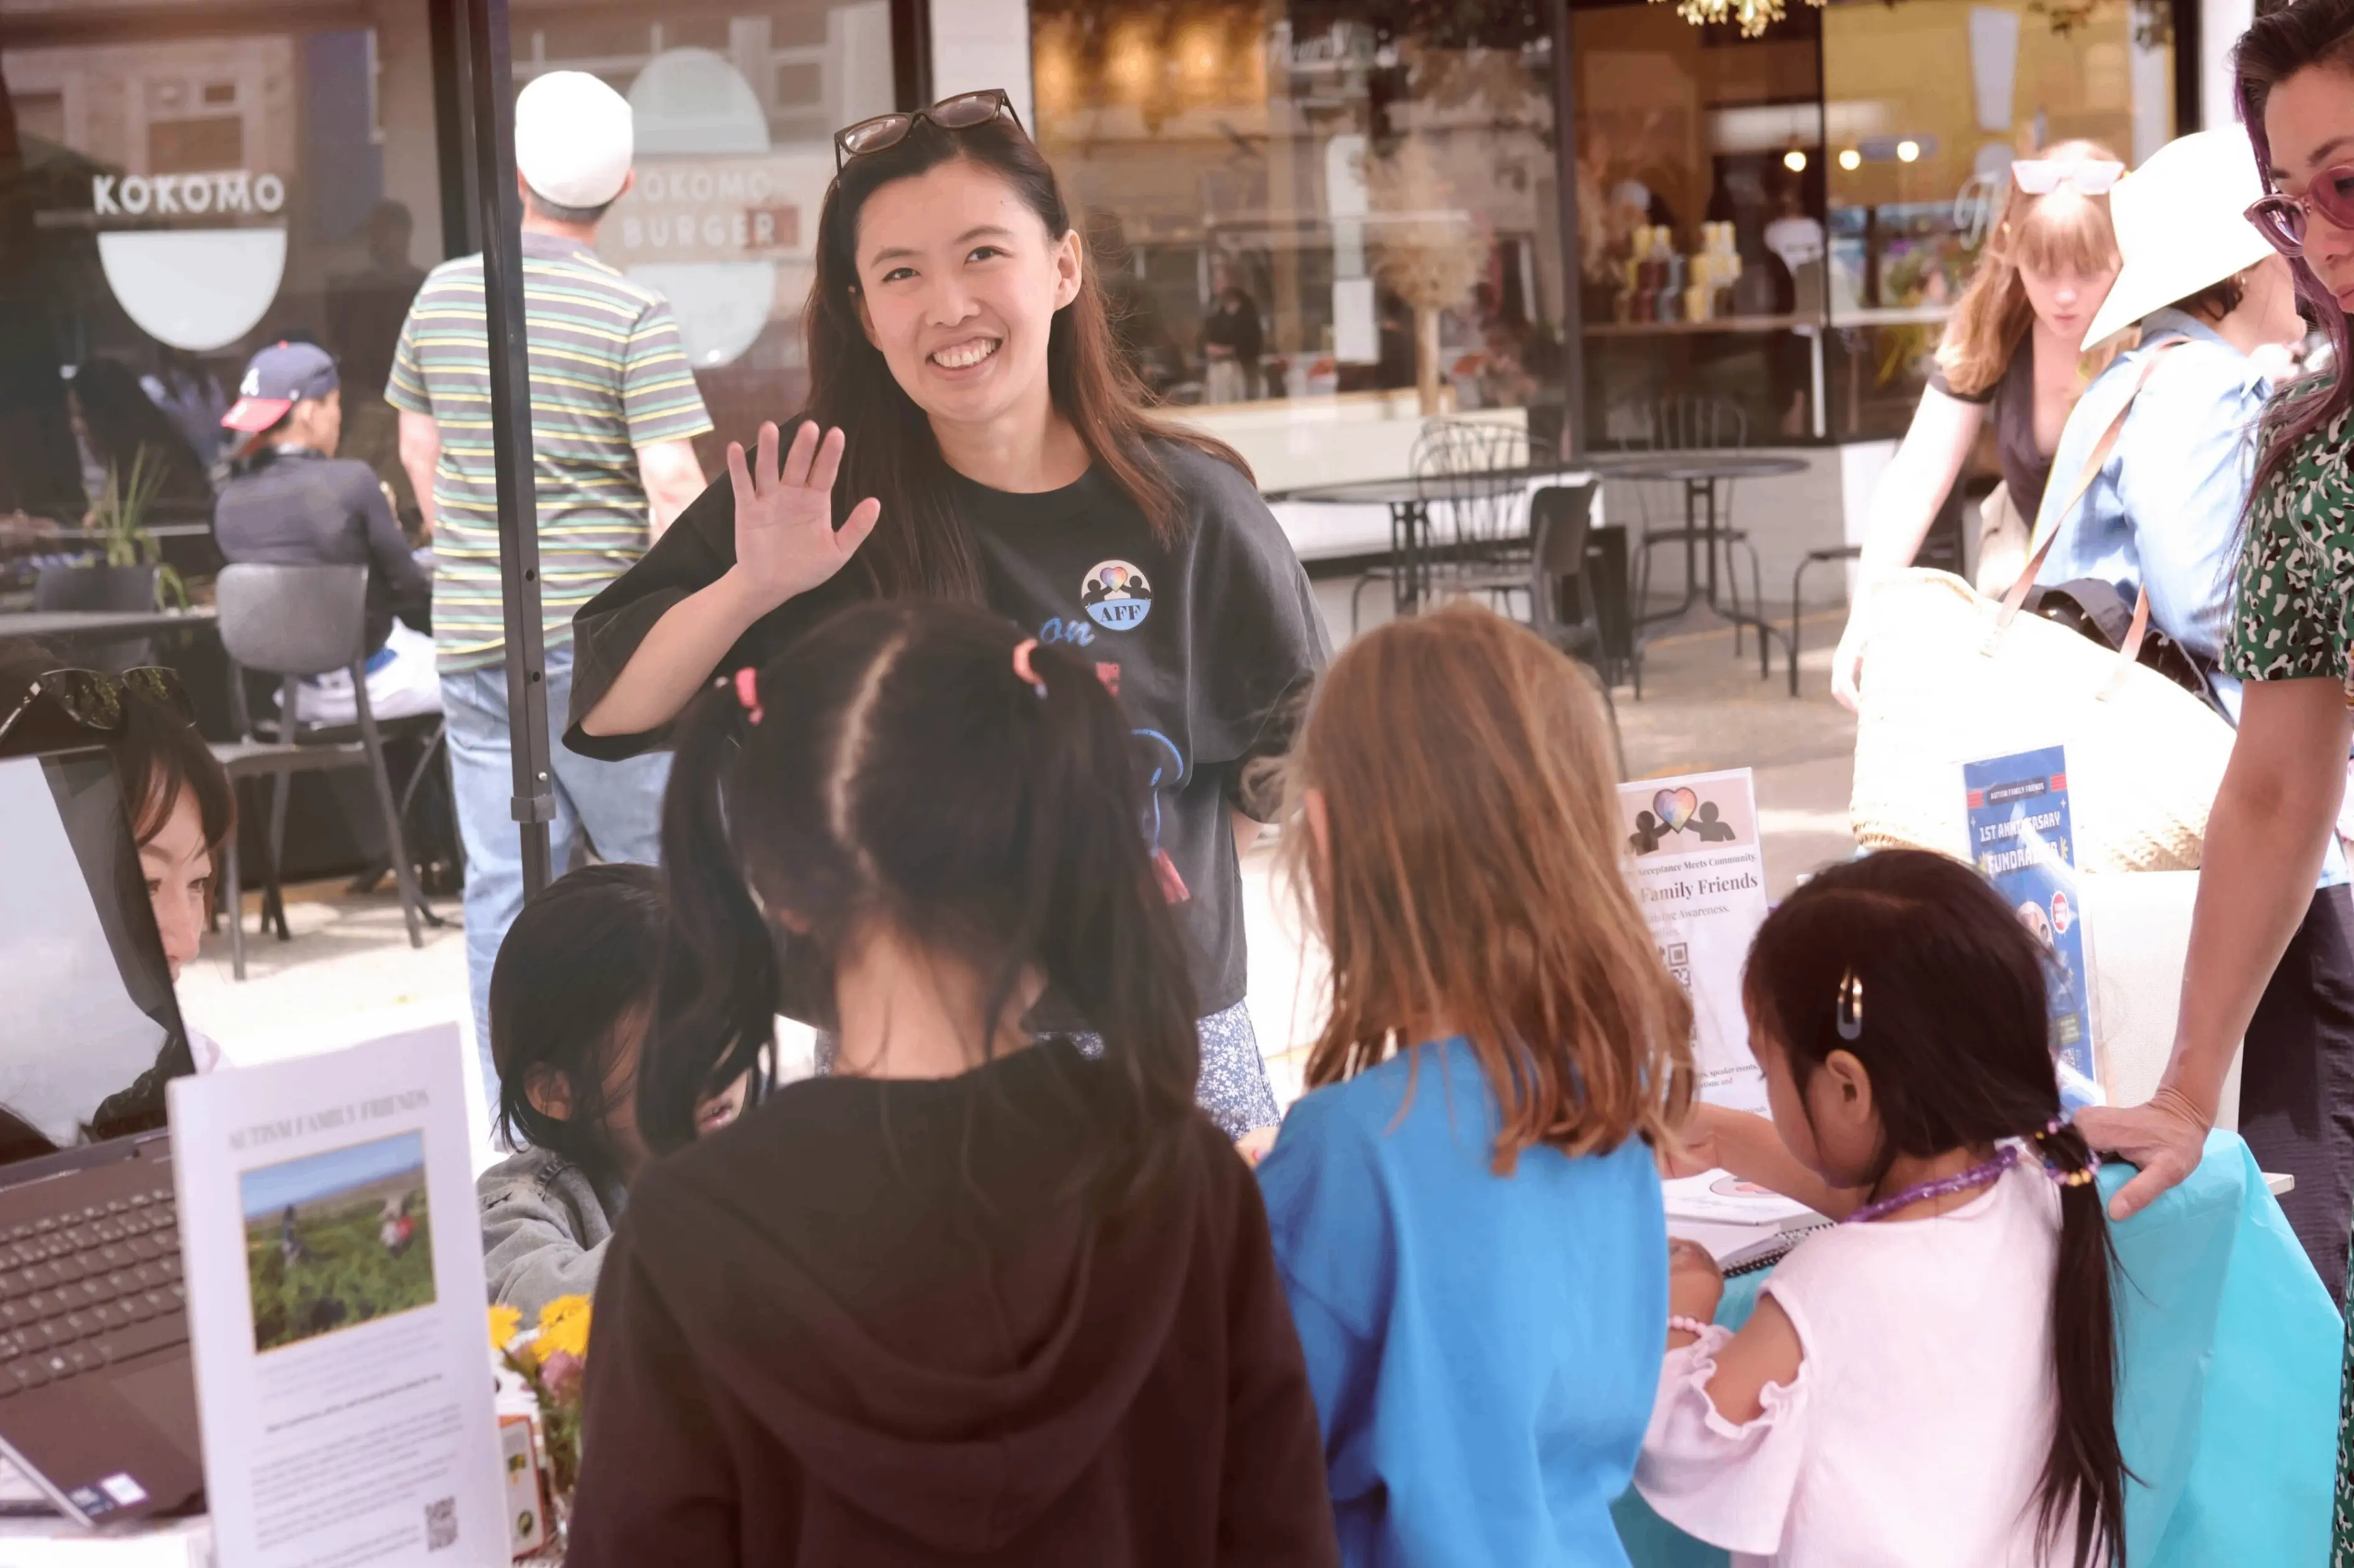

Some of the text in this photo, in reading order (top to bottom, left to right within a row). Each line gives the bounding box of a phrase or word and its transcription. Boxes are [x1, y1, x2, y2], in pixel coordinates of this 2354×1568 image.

[93, 173, 285, 215] KOKOMO
[622, 212, 775, 248] BURGER
[1101, 604, 1141, 622] AFF
[1990, 782, 2045, 800] AUTISM FAMILY FRIENDS
[1979, 824, 1996, 842] 1ST
[1684, 860, 1708, 870] Meets
[1708, 853, 1757, 867] Community.
[1640, 872, 1759, 901] Family Friends
[1679, 903, 1730, 920] Awareness.
[1710, 1067, 1735, 1077] speaker
[1721, 1077, 1733, 1085] and
